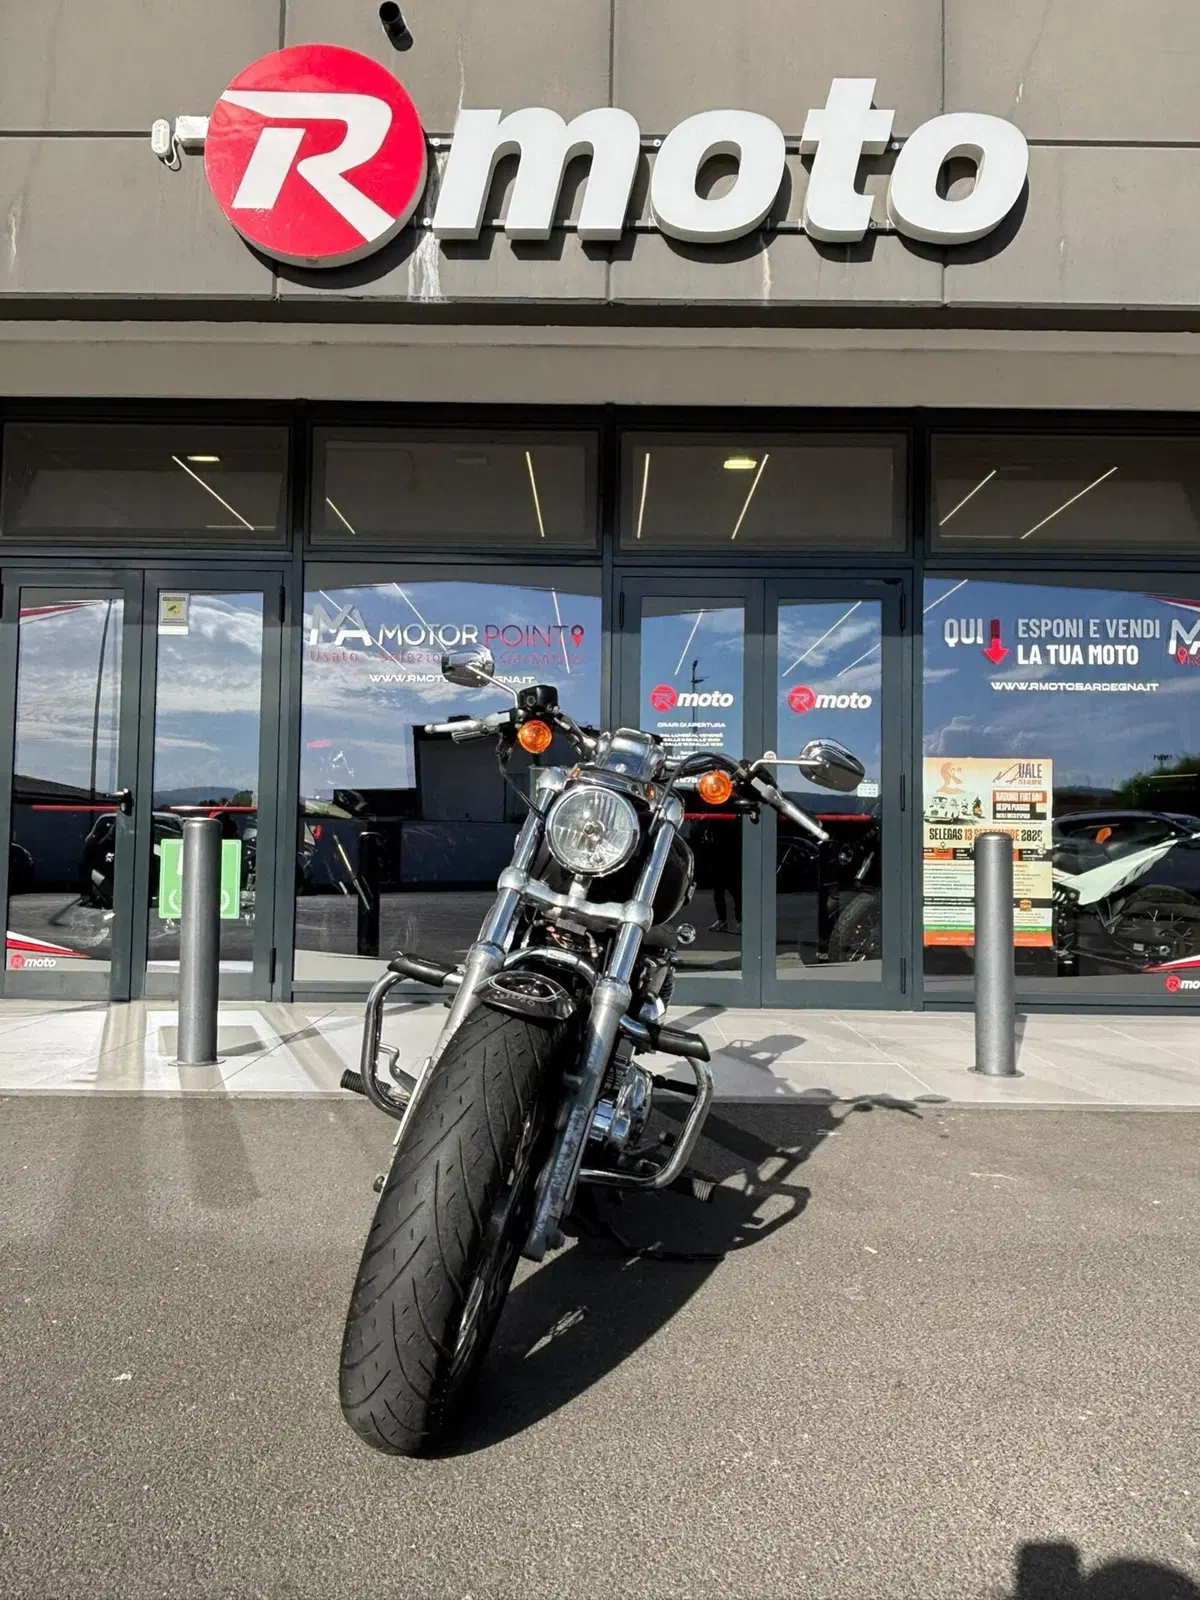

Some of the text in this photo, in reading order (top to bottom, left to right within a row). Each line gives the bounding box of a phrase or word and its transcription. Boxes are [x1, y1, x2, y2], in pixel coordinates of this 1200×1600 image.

[378, 623, 570, 648] MOTOR POINT
[944, 618, 984, 648] QUI
[1018, 618, 1160, 639] ESPONI E VENDI
[1017, 644, 1139, 666] LA TUA MOTO
[928, 828, 963, 841] SELEGAS
